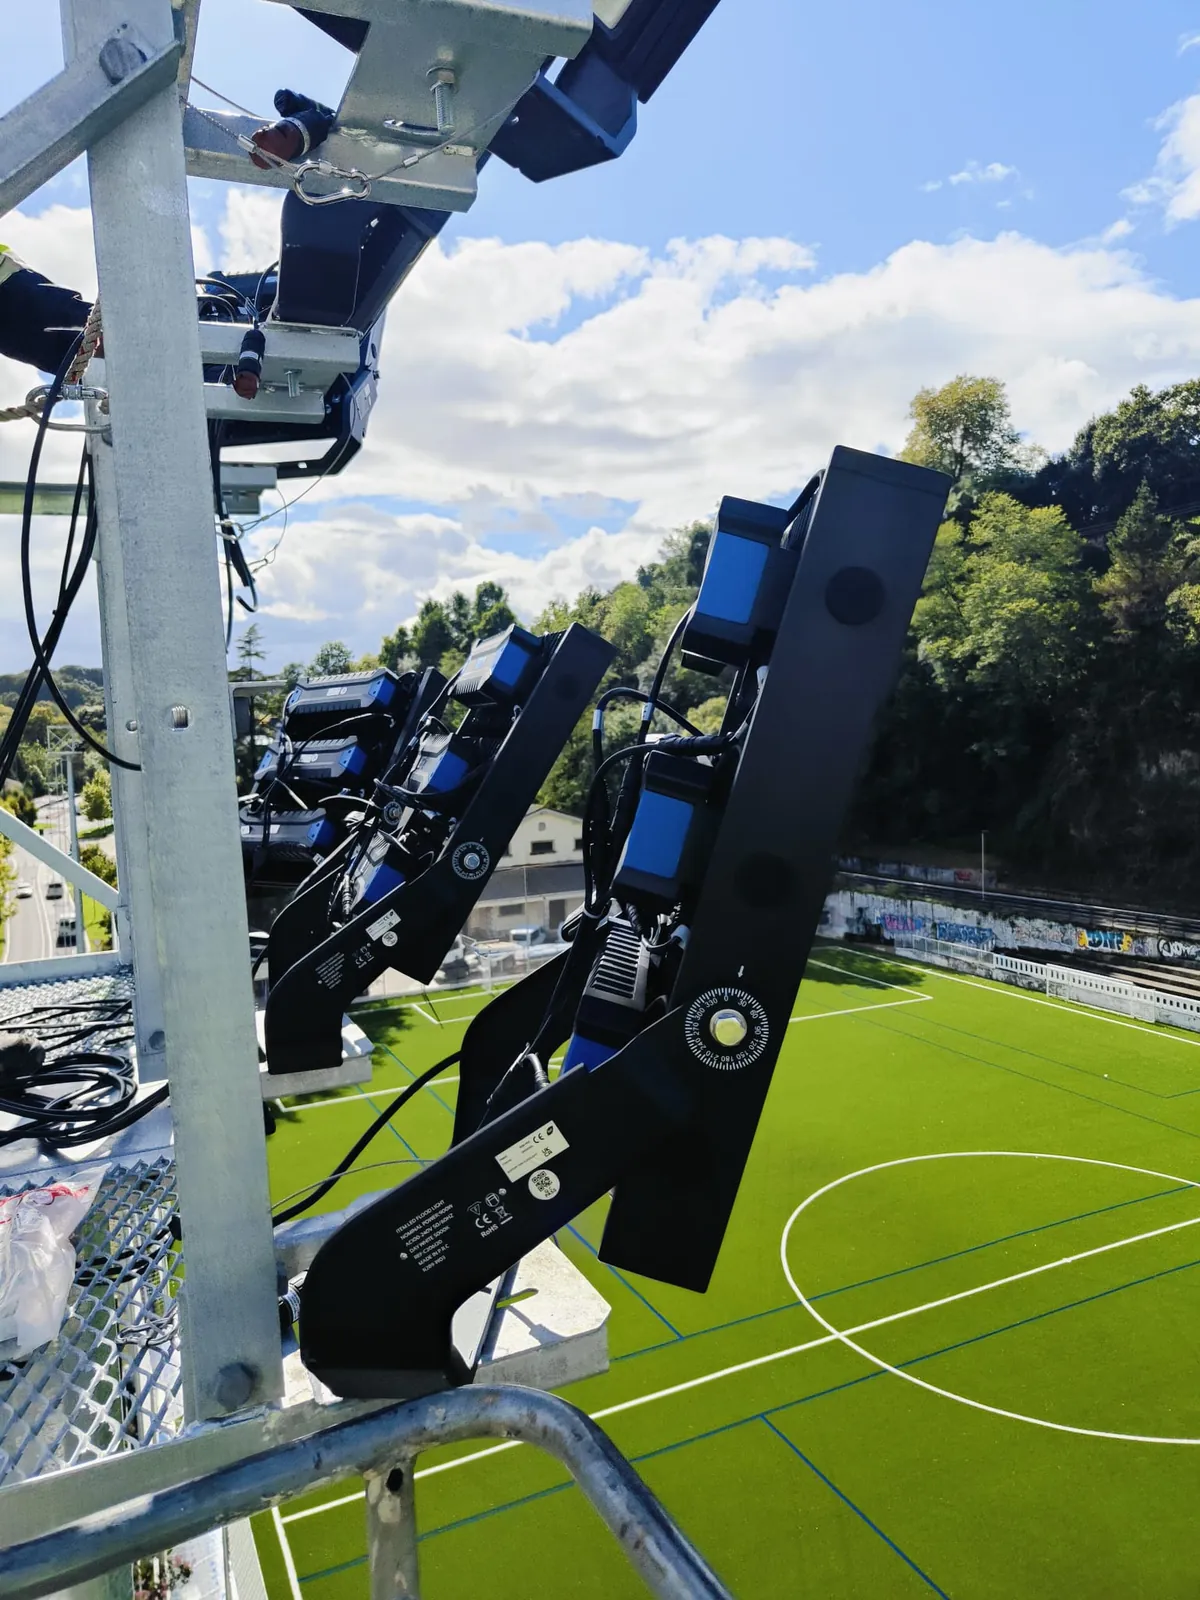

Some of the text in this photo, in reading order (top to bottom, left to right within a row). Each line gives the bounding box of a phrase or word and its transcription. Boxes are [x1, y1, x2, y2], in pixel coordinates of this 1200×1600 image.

[705, 998, 718, 1007] 330
[738, 999, 747, 1007] 30
[694, 1008, 705, 1020] 300
[750, 1010, 758, 1019] 60
[755, 1026, 761, 1035] 90
[695, 1038, 706, 1050] 240
[749, 1039, 758, 1050] 120
[706, 1051, 719, 1060] 210
[736, 1051, 748, 1059] 150
[533, 1133, 544, 1143] CE
[475, 1213, 492, 1228] CE
[480, 1224, 499, 1238] RoHS
